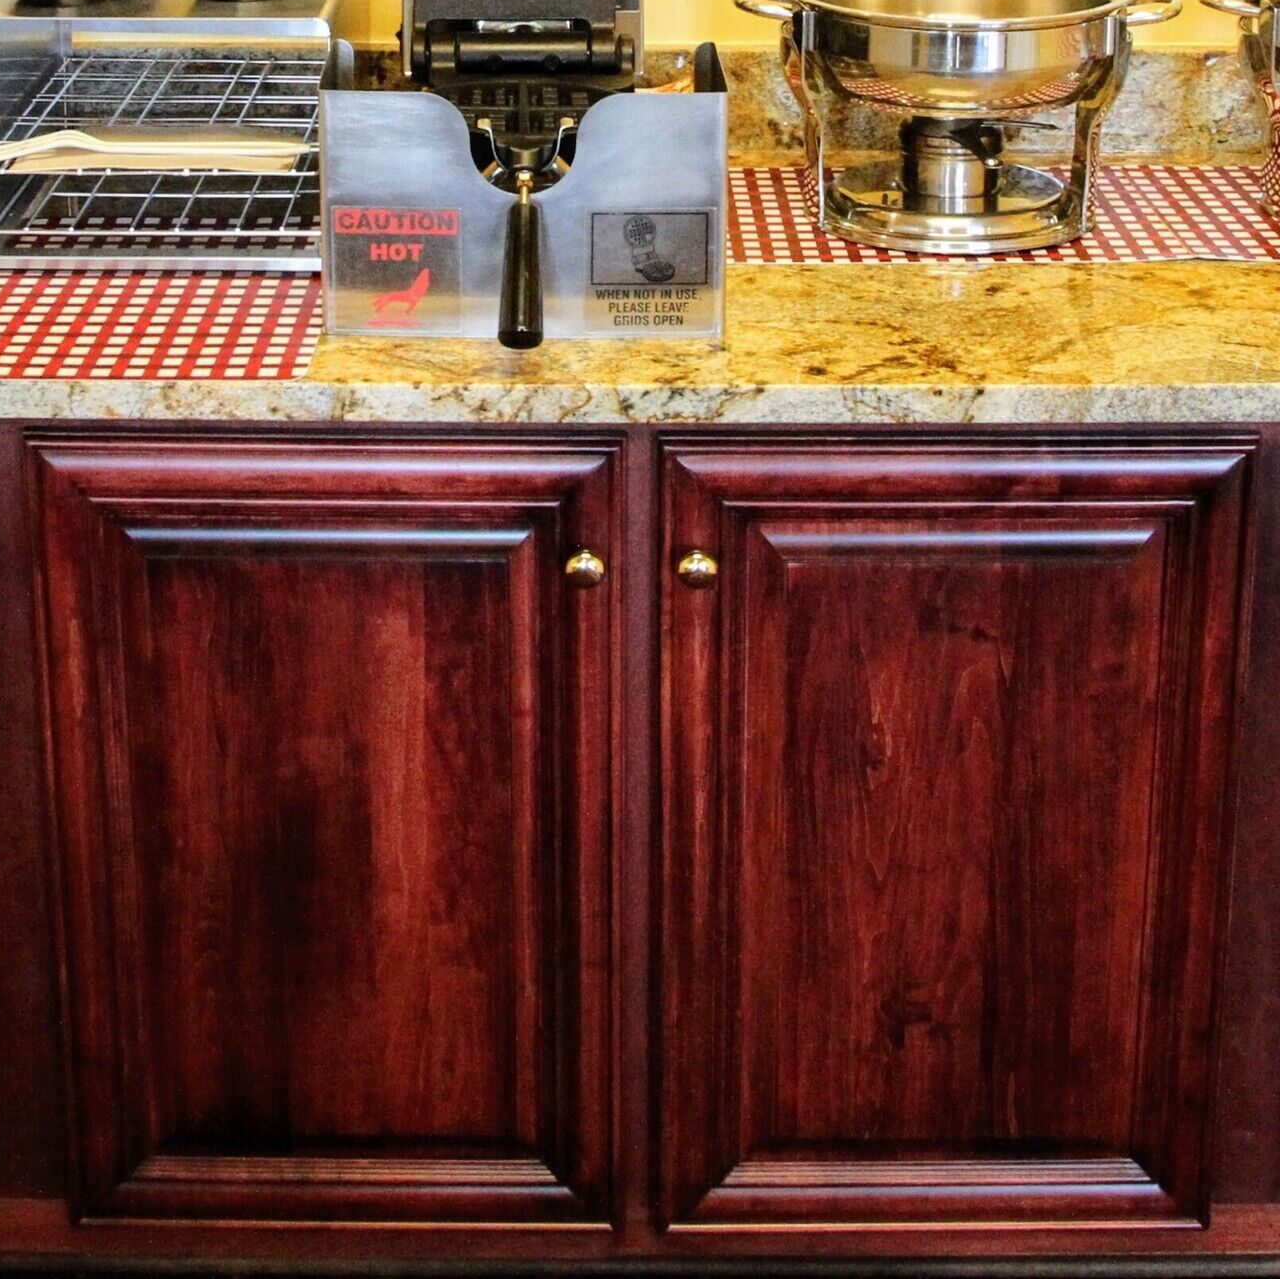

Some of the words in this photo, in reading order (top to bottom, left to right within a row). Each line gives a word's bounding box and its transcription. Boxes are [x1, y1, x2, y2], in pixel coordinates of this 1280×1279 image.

[338, 212, 454, 230] CAUTION
[369, 242, 424, 262] HOT
[595, 289, 630, 300] WHEN
[633, 289, 657, 299] NOT
[660, 288, 672, 299] IN
[608, 302, 651, 313] PLEASE
